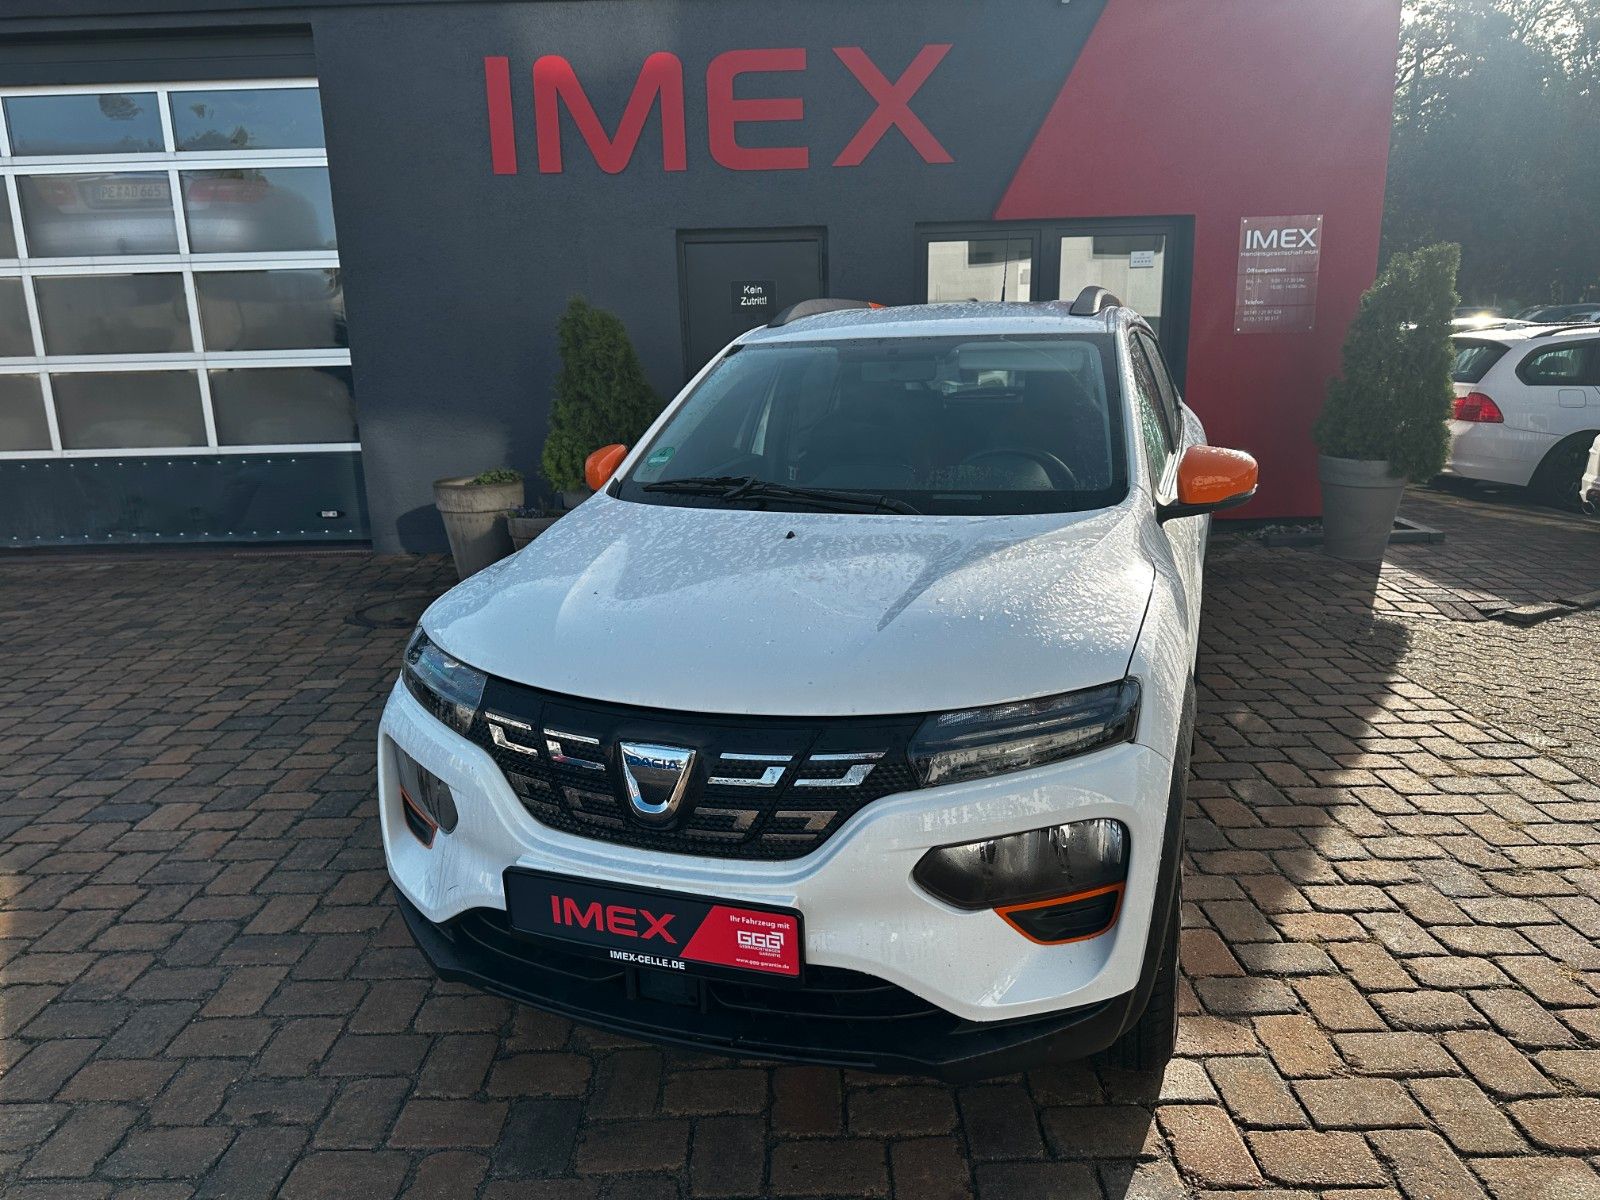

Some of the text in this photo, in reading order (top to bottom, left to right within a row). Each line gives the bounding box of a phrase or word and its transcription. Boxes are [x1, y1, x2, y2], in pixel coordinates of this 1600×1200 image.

[484, 43, 956, 175] IMEX
[1245, 228, 1318, 249] IMEX
[743, 285, 763, 294] Kein
[740, 296, 767, 306] Zutritt!
[629, 756, 679, 770] DACIA
[551, 894, 678, 945] IMEX
[729, 915, 791, 930] Ihr Fahrzeug mit
[737, 930, 785, 949] GGG
[609, 950, 686, 970] IMEX-CELLE.DE
